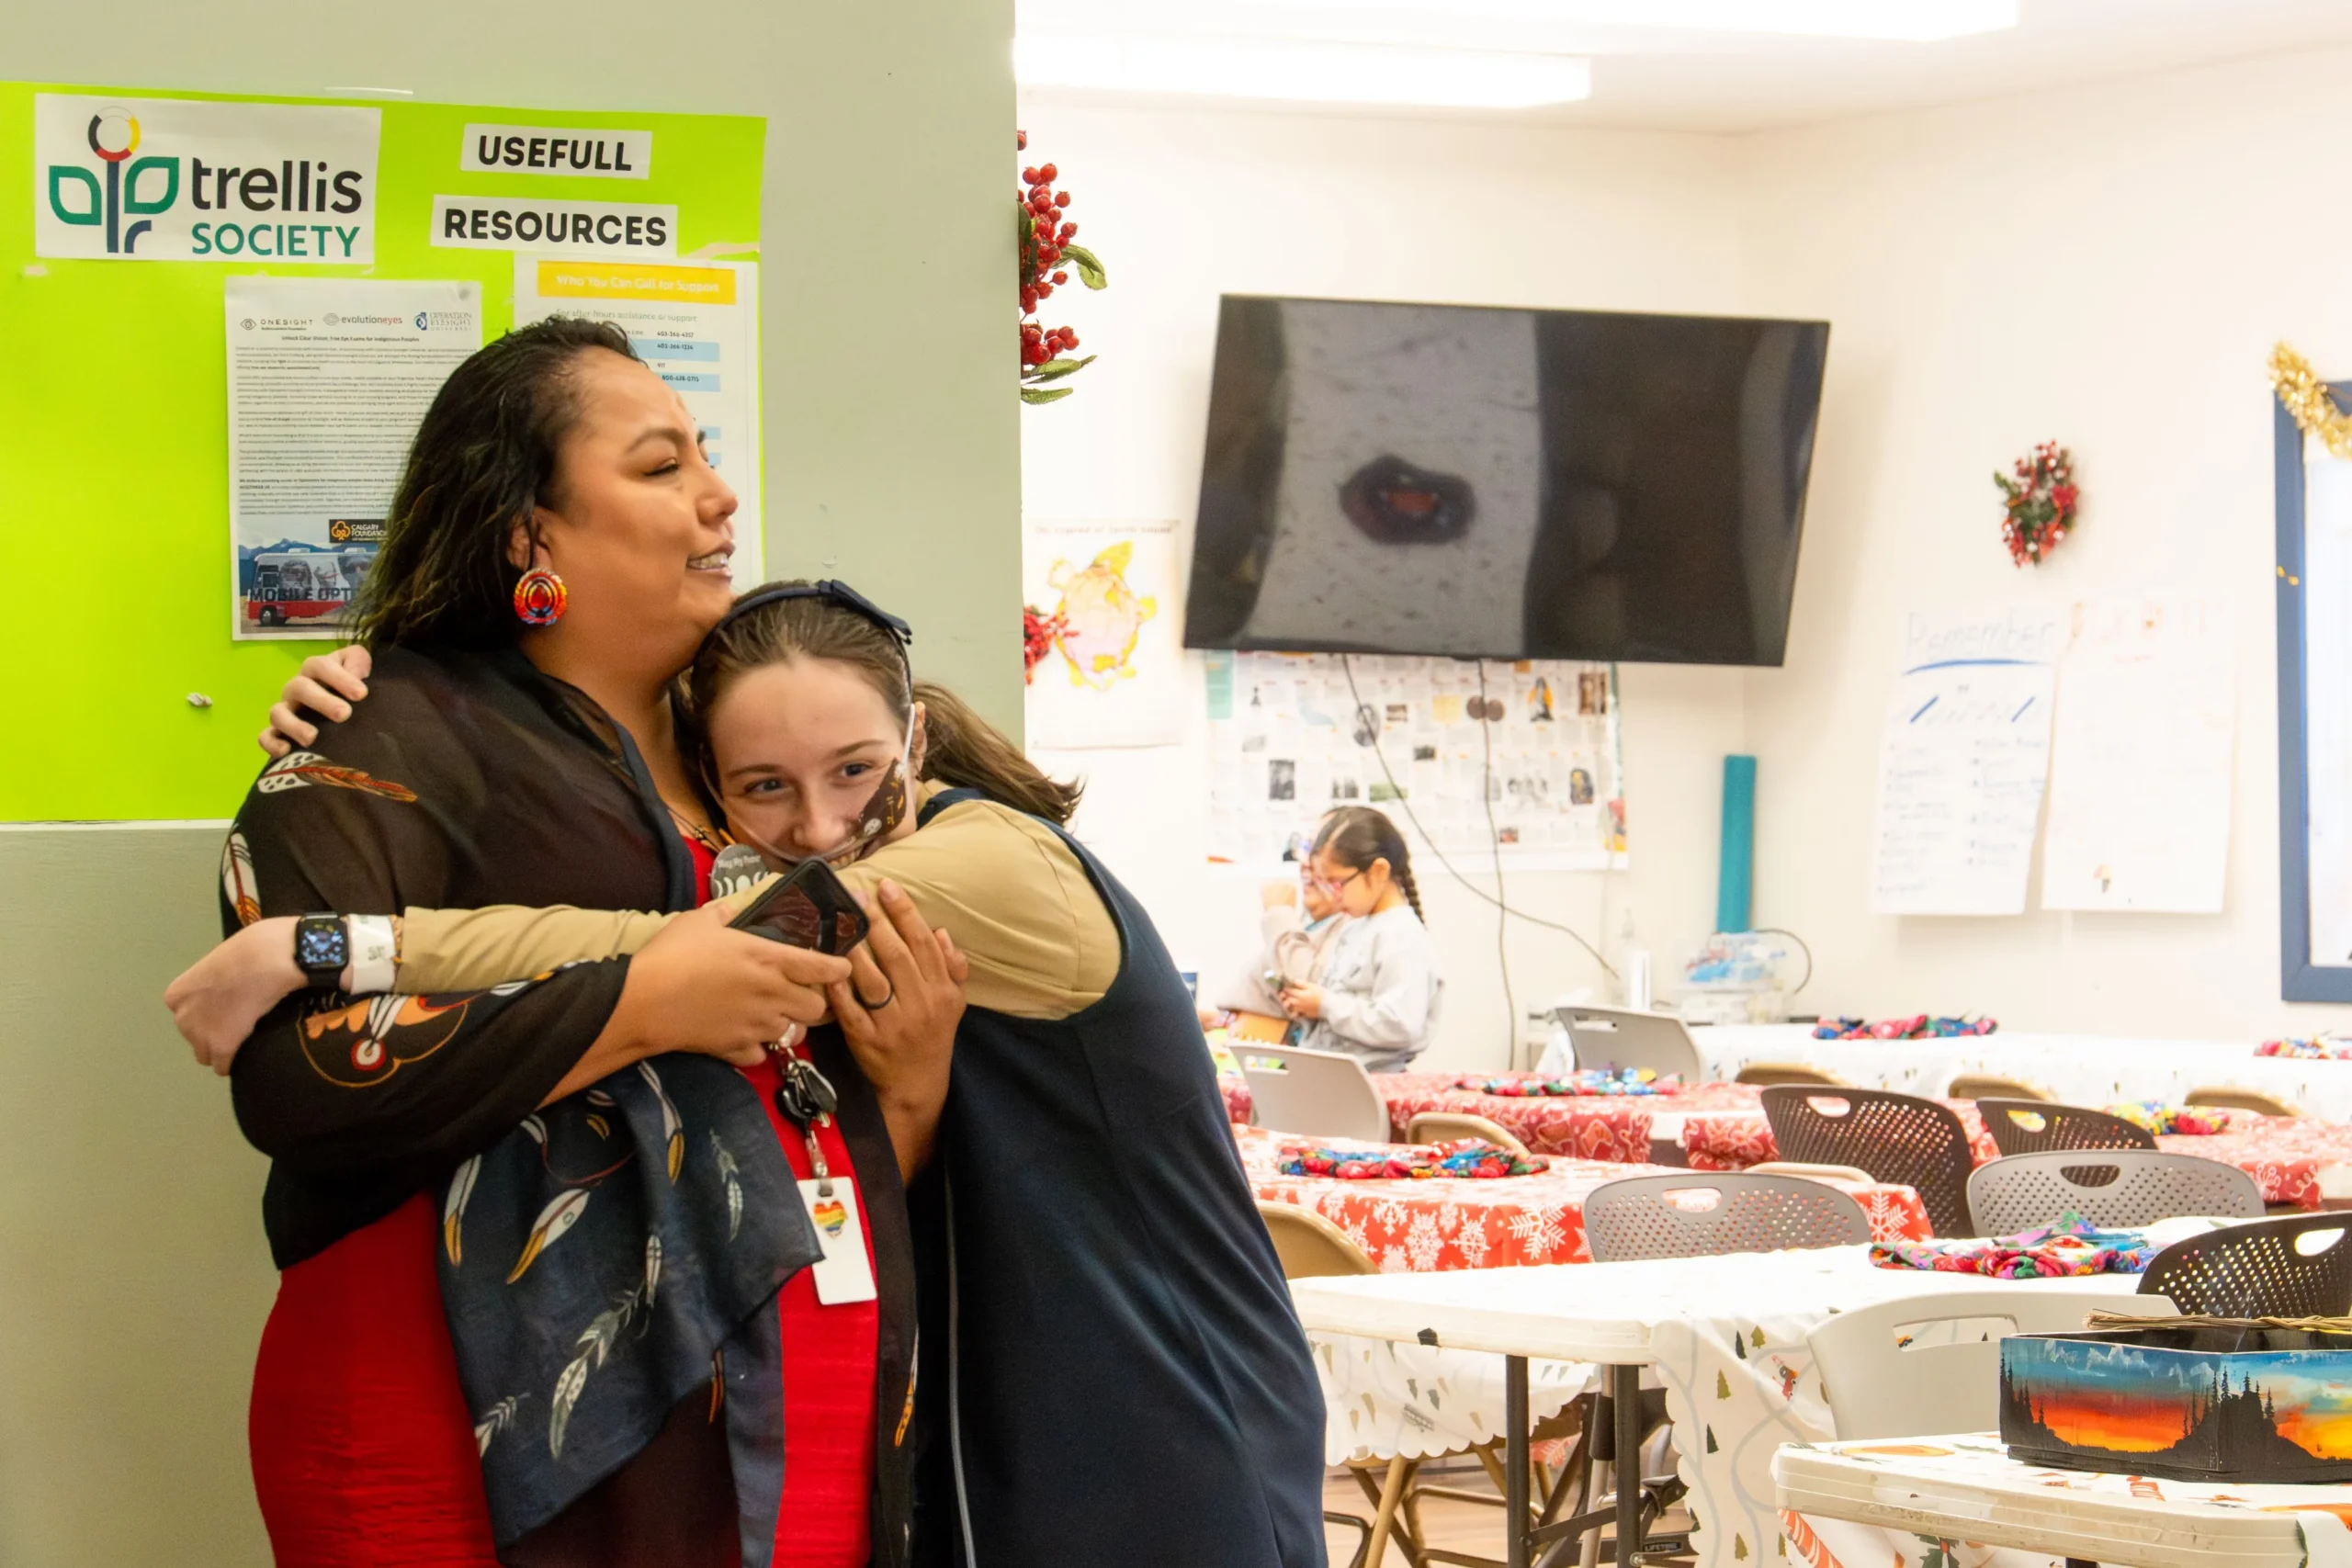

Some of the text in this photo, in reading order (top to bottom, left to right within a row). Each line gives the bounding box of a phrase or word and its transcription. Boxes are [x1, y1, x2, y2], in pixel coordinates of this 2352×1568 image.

[478, 135, 633, 172] USEFULL
[192, 157, 363, 214] trellis
[191, 221, 361, 258] SOCIETY
[444, 208, 667, 248] RESOURCES
[556, 275, 720, 294] Who You Can Call for Support
[341, 315, 403, 326] evolutioneyes
[249, 588, 314, 602] MOBILE
